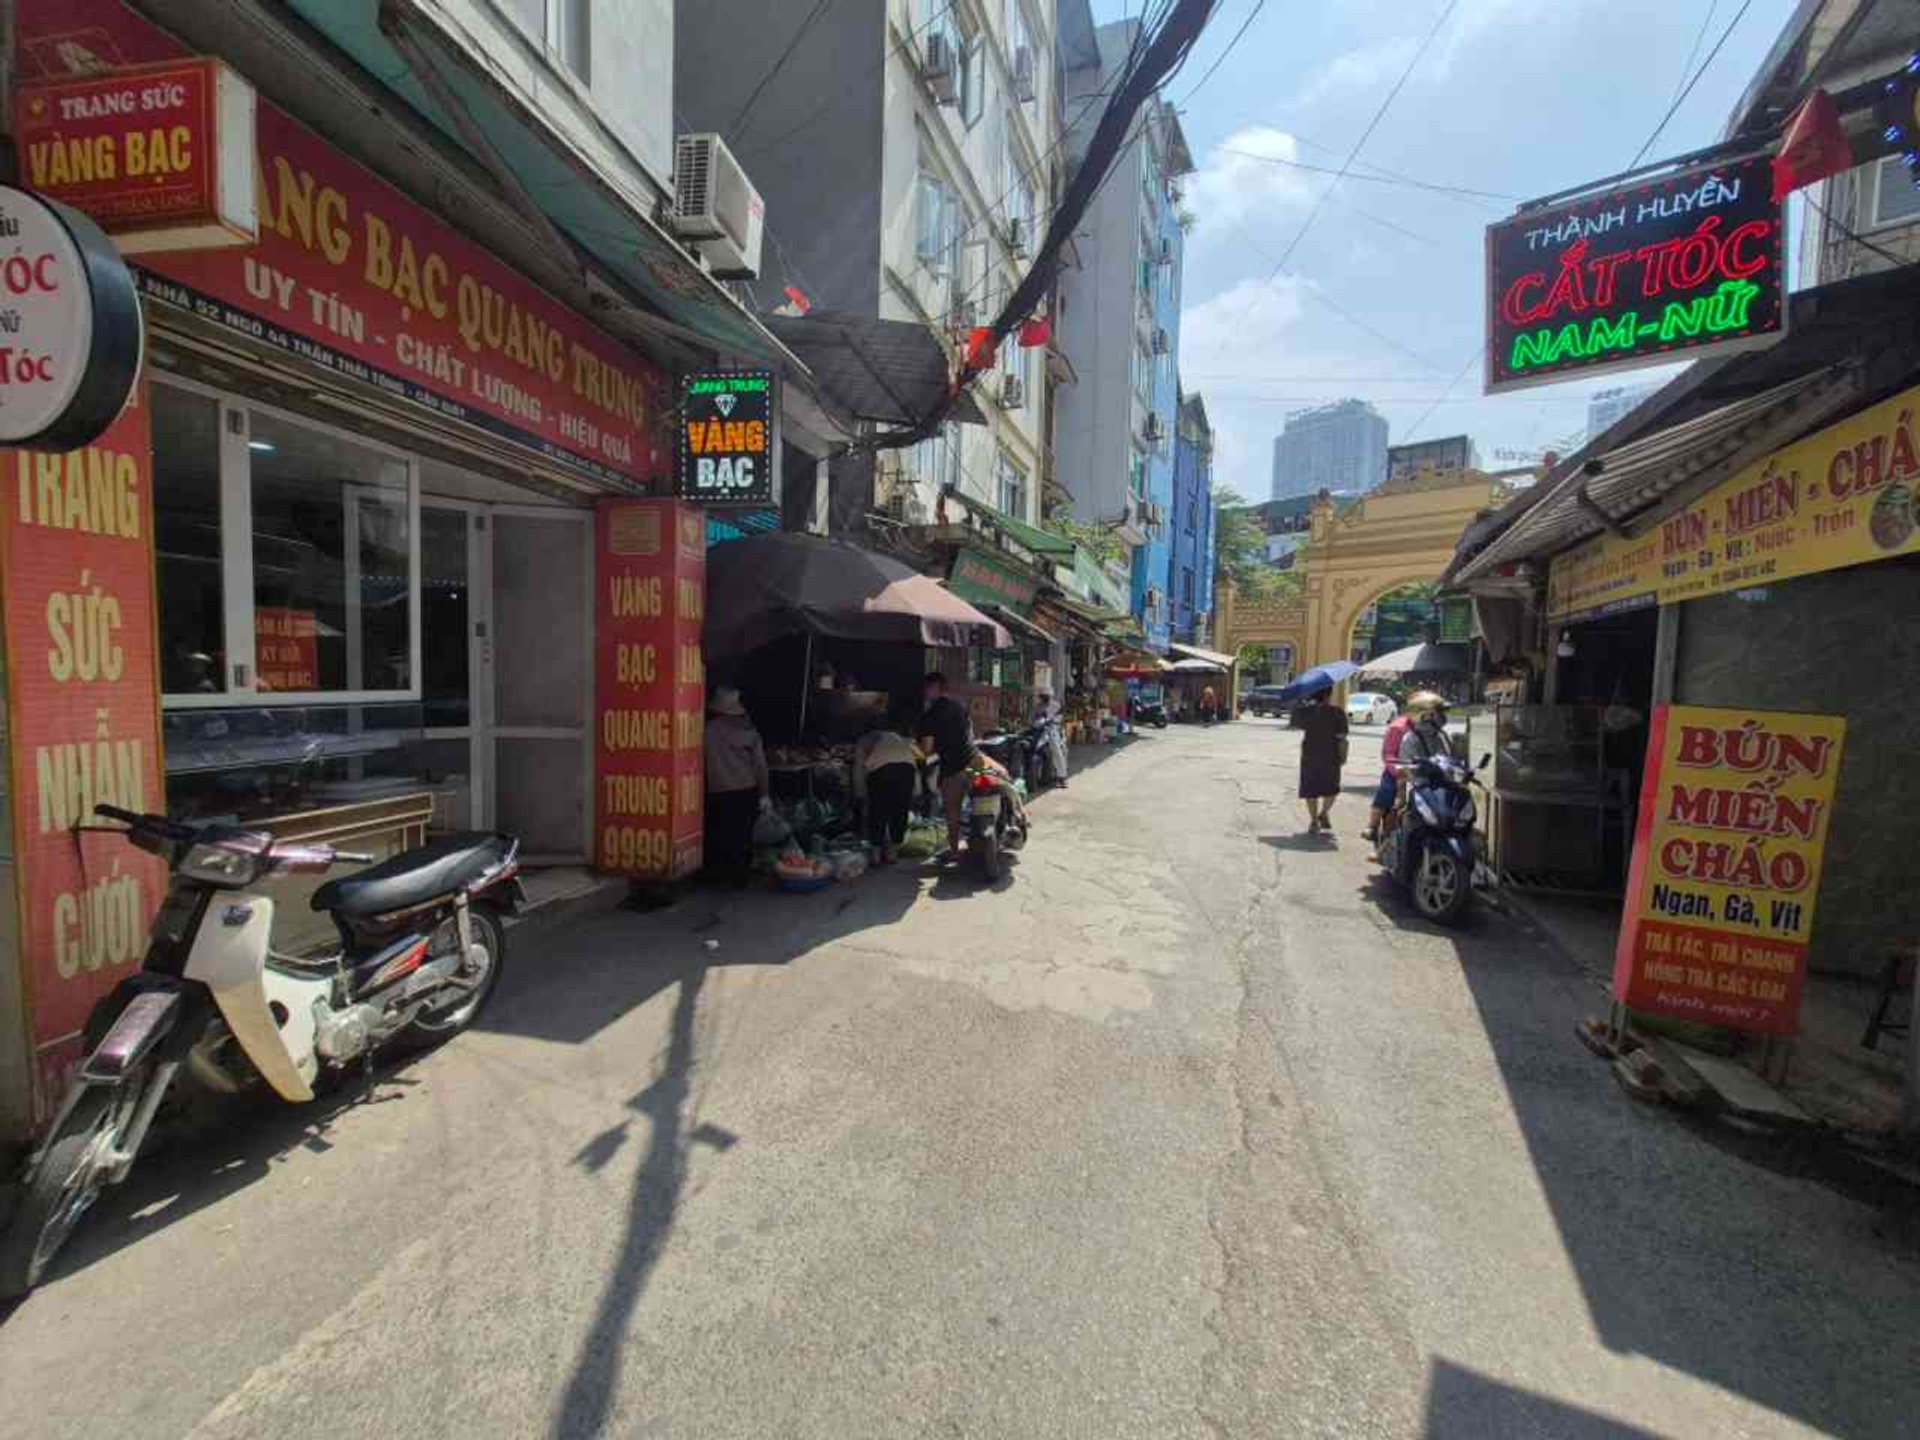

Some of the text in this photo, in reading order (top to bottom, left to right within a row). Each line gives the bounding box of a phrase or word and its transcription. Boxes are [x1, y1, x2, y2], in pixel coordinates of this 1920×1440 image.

[60, 82, 185, 120] TRANG SỨC
[29, 126, 192, 187] VÀNG BẠC
[1525, 174, 1742, 251] THÀNH HUYỀN
[0, 246, 58, 295] ÓC
[1503, 215, 1772, 325] CẮT TÓC
[364, 211, 448, 323] BẠC
[457, 273, 563, 381] QUANG
[571, 341, 645, 429] TRUNG
[1511, 278, 1760, 369] NAM-NỮ
[243, 256, 295, 312] UY
[307, 285, 364, 344] TÍN
[396, 331, 466, 388] CHẤT
[472, 366, 541, 424] LƯỢNG
[559, 411, 599, 450] HIỆU
[688, 416, 765, 454] VÀNG
[697, 456, 755, 494] BẠC
[610, 565, 662, 617] VÀNG
[47, 568, 122, 682] SỨC
[616, 643, 656, 693] BẠC
[603, 708, 671, 753] QUANG
[1676, 718, 1834, 779] BÚN
[603, 773, 669, 817] TRUNG
[1668, 776, 1824, 840] MIẾN
[603, 825, 669, 872] 9999
[1660, 836, 1813, 894] CHÁO
[1652, 883, 1802, 936] Ngan, Gà, Vịt
